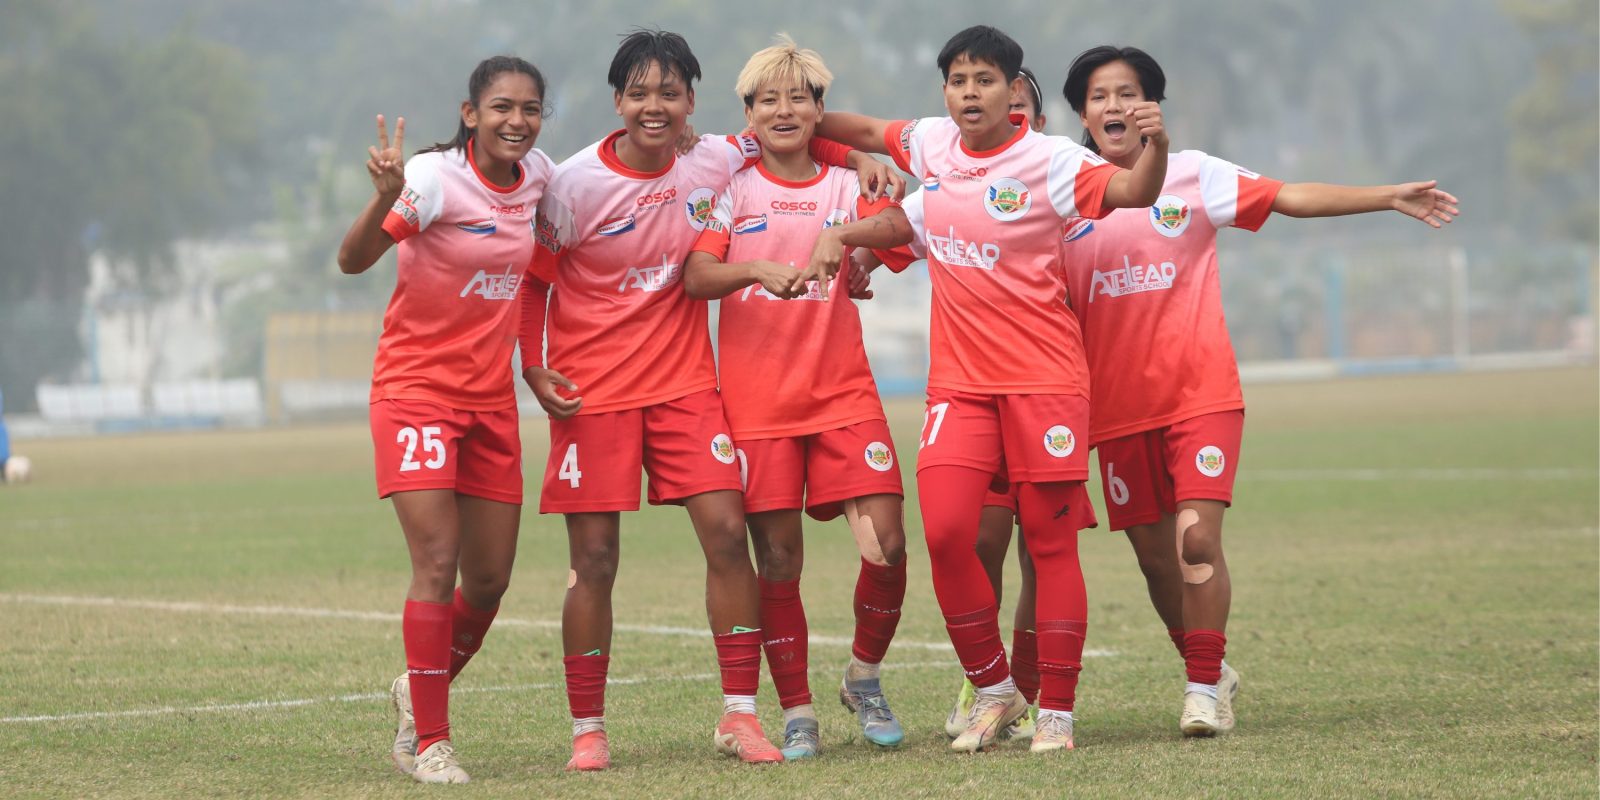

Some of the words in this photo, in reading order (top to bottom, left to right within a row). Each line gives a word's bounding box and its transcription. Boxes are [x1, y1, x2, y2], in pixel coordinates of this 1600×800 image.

[637, 188, 677, 207] COSCO
[770, 200, 817, 212] COSCO
[1089, 255, 1176, 303] ATHLEAD
[1119, 285, 1142, 294] SPORTS
[396, 426, 447, 472] 25
[558, 443, 582, 489] 4
[1107, 462, 1130, 506] 6
